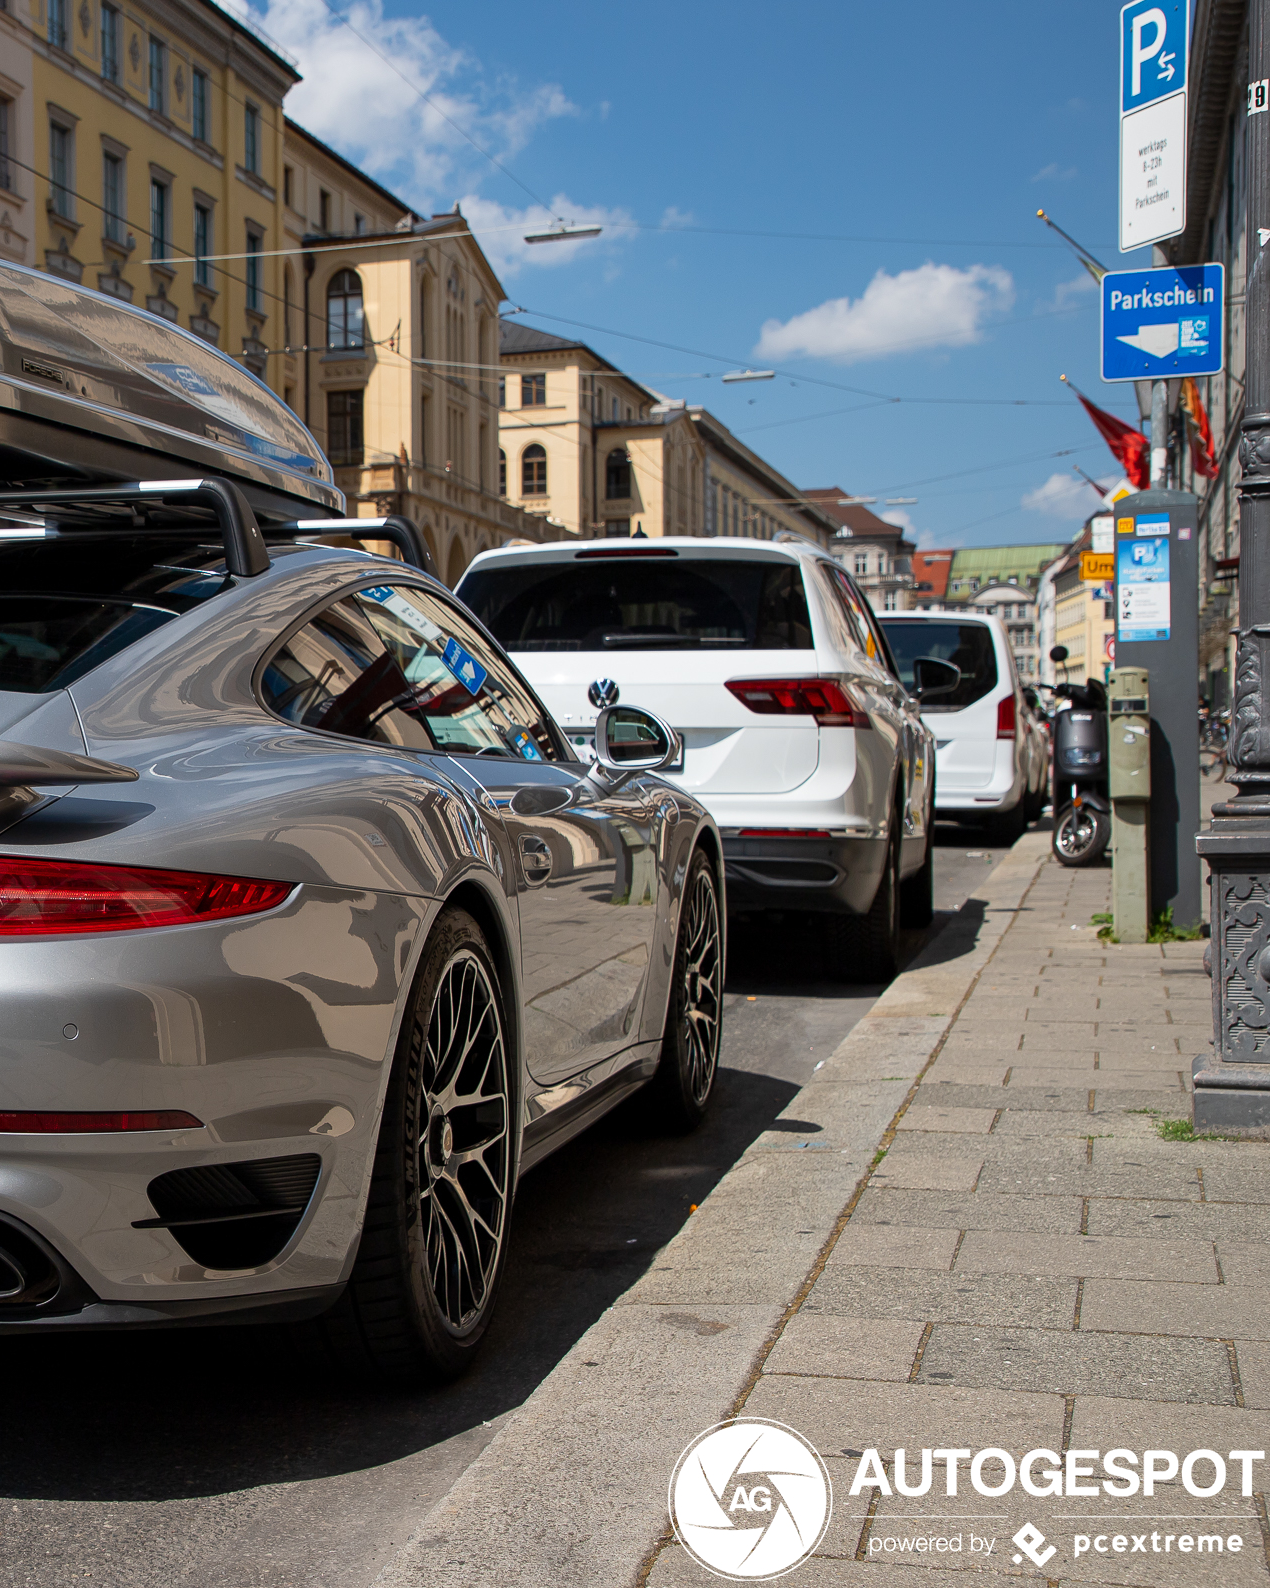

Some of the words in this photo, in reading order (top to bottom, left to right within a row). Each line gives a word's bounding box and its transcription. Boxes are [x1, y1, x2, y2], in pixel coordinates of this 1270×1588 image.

[1139, 138, 1167, 157] werktags
[1147, 174, 1158, 189] mit
[1135, 188, 1170, 210] Parkschein
[1111, 285, 1214, 311] Parkschein
[23, 361, 63, 381] PORSCHE
[405, 1026, 422, 1184] MICHELIN
